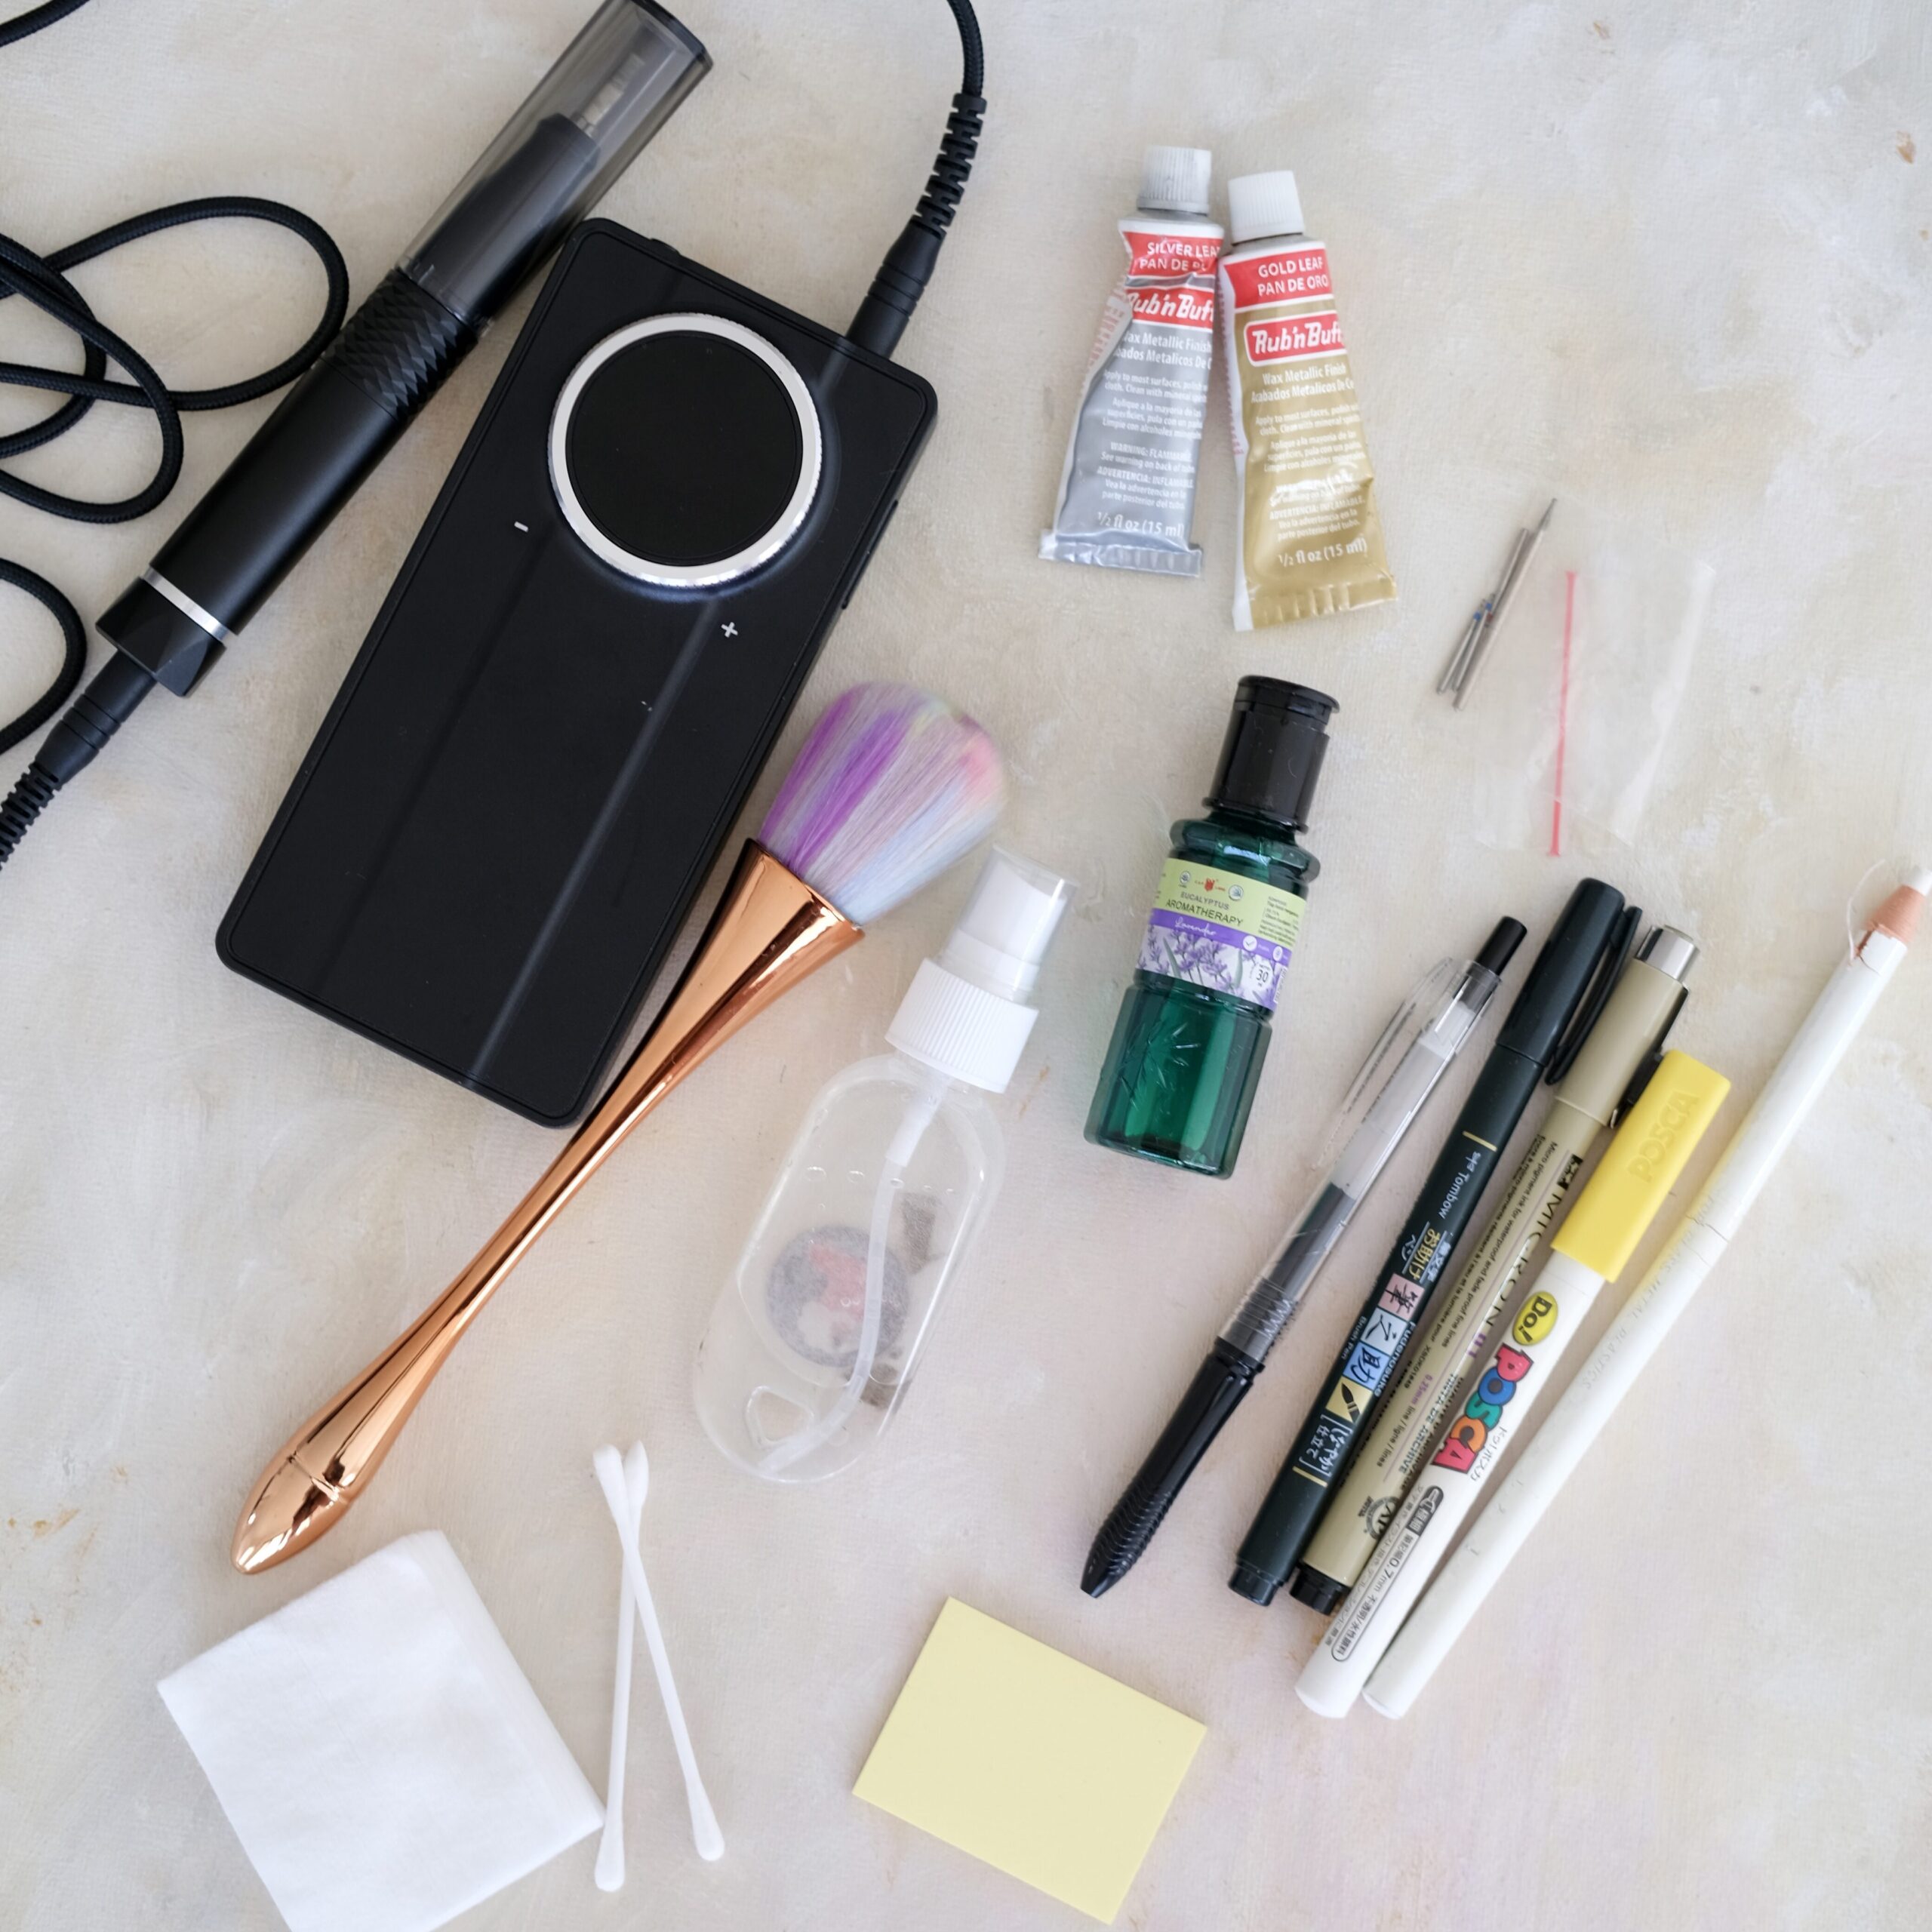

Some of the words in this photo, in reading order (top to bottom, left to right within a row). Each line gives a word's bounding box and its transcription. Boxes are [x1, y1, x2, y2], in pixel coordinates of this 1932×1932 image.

[1147, 242, 1192, 257] SILVER
[1140, 259, 1167, 270] PAN
[1171, 259, 1189, 272] DE
[1258, 260, 1297, 278] GOLD
[1298, 257, 1323, 272] LEAF
[1257, 281, 1285, 297] PAN
[1287, 277, 1306, 293] DE
[1306, 274, 1329, 289] ORO
[1142, 332, 1183, 350] Metallic
[1186, 338, 1212, 353] Finish
[1252, 326, 1306, 355] Rub'n
[1146, 349, 1193, 367] Metalicos
[1195, 355, 1206, 369] De
[1122, 373, 1130, 381] to
[1263, 372, 1283, 386] Wax
[1284, 366, 1323, 383] Metallic
[1324, 362, 1346, 377] Finish
[1251, 387, 1291, 403] Acabados
[1292, 381, 1336, 398] Metalicos
[1337, 379, 1345, 390] De
[1100, 451, 1114, 461] See
[1109, 441, 1149, 456] WARNING:
[1113, 514, 1124, 528] fl
[1125, 520, 1140, 531] oz
[1142, 519, 1162, 535] (15
[1296, 549, 1306, 564] fl
[1307, 551, 1322, 562] oz
[1324, 543, 1343, 561] (15
[1180, 891, 1230, 911] EUCALYPTUS
[1165, 898, 1244, 927] AROMATHERAPY
[1174, 916, 1217, 937] Lavender
[1256, 968, 1269, 983] 30
[1628, 1089, 1699, 1183] POSCA
[1540, 1140, 1558, 1164] Micro
[1522, 1162, 1546, 1195] pigment
[1436, 1169, 1469, 1220] Tombow
[1516, 1194, 1528, 1208] ink
[1510, 1207, 1521, 1220] for
[1487, 1217, 1516, 1261] waterproof
[1408, 1229, 1441, 1281] お助け
[1479, 1260, 1494, 1276] and
[1470, 1275, 1484, 1294] fade
[1458, 1292, 1475, 1315] proof
[1349, 1315, 1367, 1341] Brush
[1451, 1314, 1464, 1331] fine
[1514, 1294, 1553, 1344] Do!
[1349, 1279, 1420, 1384] 筆之助
[1441, 1328, 1456, 1349] lines
[1340, 1340, 1354, 1360] Pen
[1372, 1321, 1417, 1398] Fudenosuke
[1410, 1373, 1433, 1405] 0.25mm
[1401, 1404, 1415, 1421] line
[1432, 1342, 1534, 1475] POSCA
[1304, 1423, 1331, 1459] 仕立て
[1387, 1423, 1405, 1444] ligne
[1313, 1426, 1349, 1472] しなやか
[1375, 1447, 1392, 1468] lines
